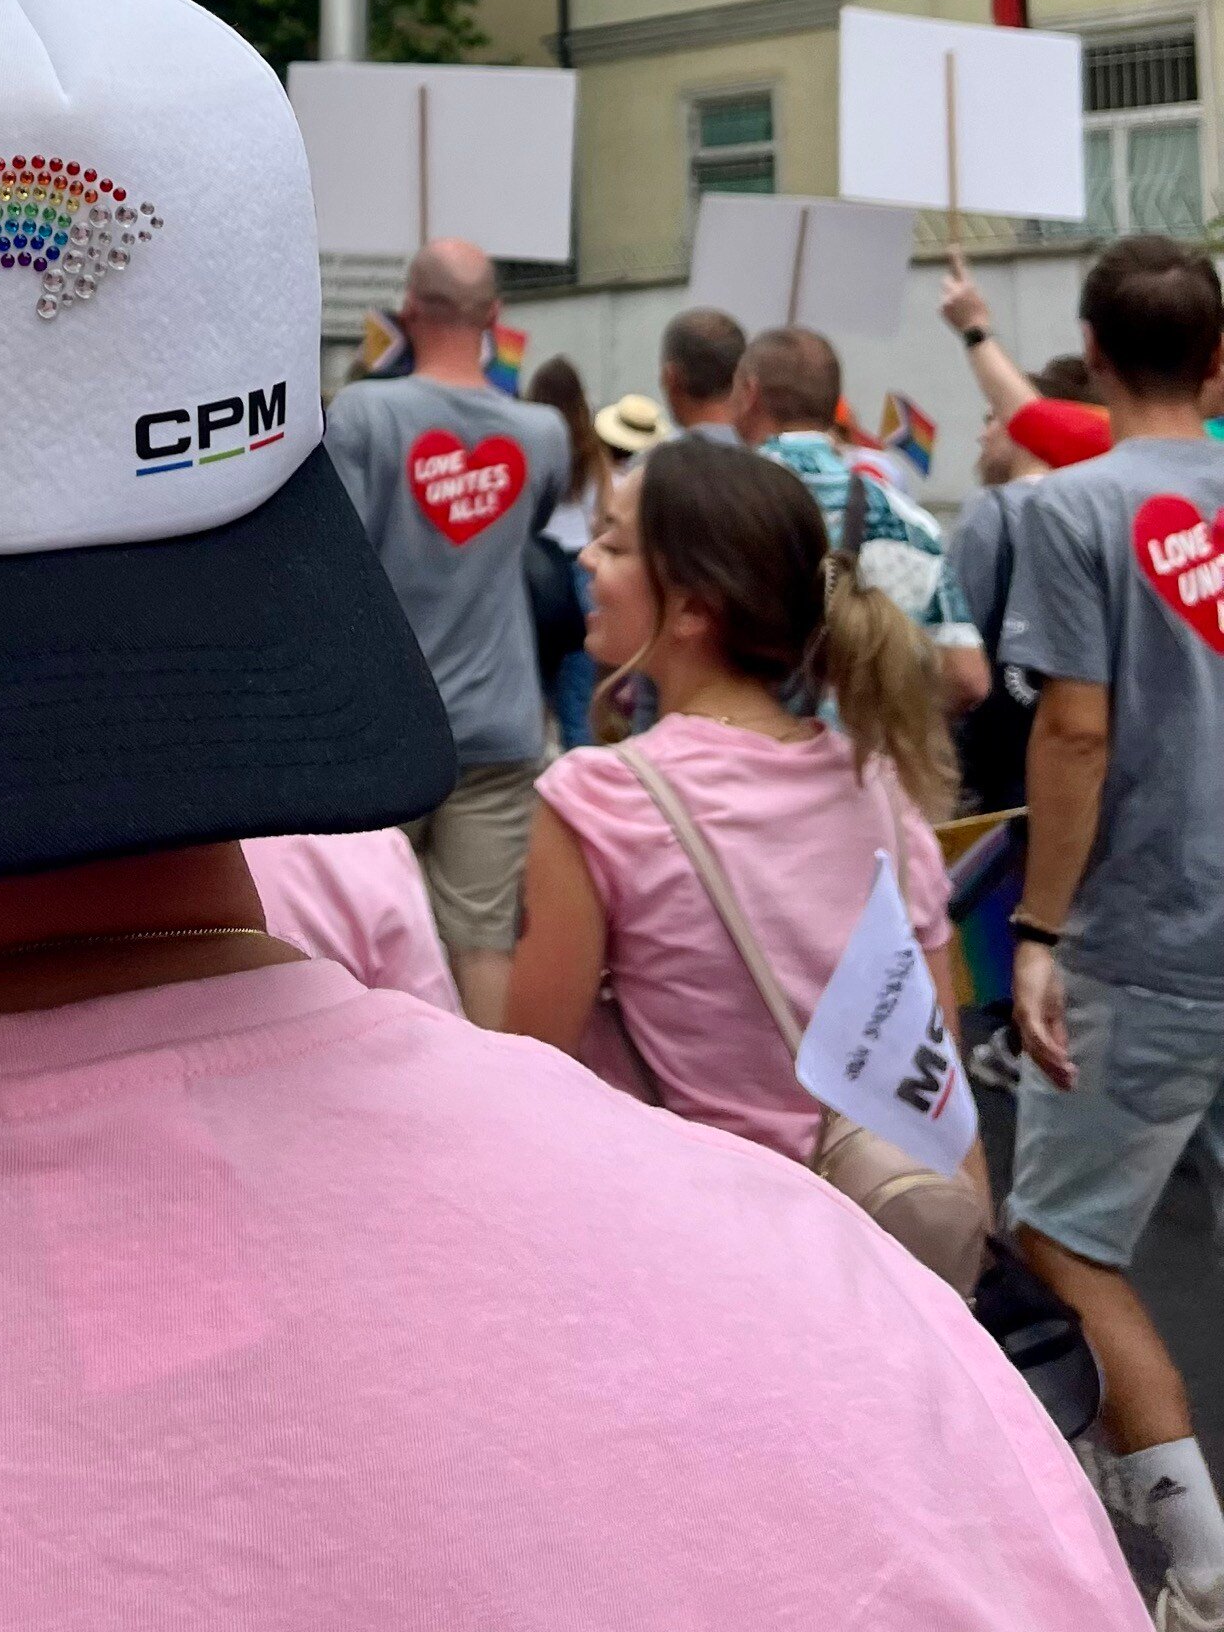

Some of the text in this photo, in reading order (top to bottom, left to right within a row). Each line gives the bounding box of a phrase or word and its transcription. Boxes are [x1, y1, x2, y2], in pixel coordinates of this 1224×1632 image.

[135, 381, 287, 460] CPM
[414, 449, 466, 482] LOVE
[1147, 521, 1212, 576] LOVE
